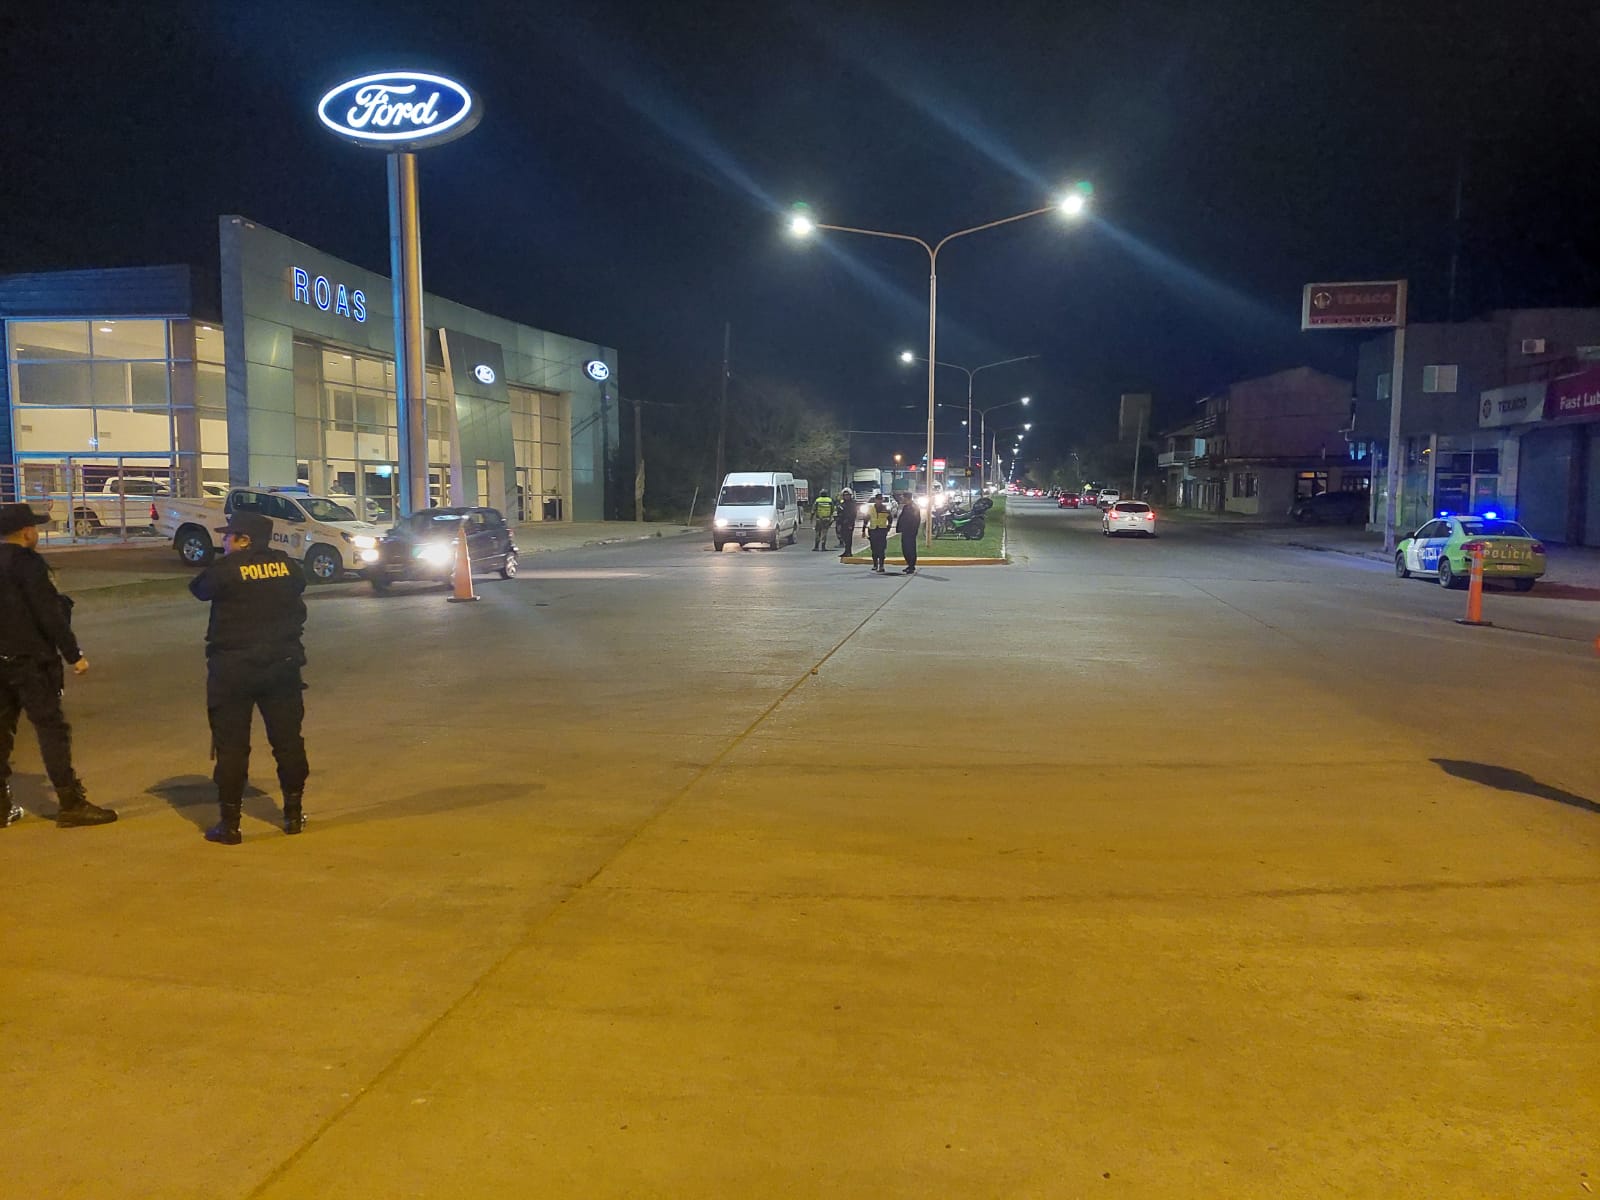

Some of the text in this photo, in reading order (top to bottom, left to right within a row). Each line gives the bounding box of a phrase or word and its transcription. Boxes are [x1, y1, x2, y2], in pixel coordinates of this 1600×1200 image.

[346, 84, 440, 128] Ford
[291, 266, 367, 323] ROAS
[1560, 395, 1581, 410] Fast
[1483, 549, 1532, 560] POLICIA
[240, 562, 290, 580] POLICIA
